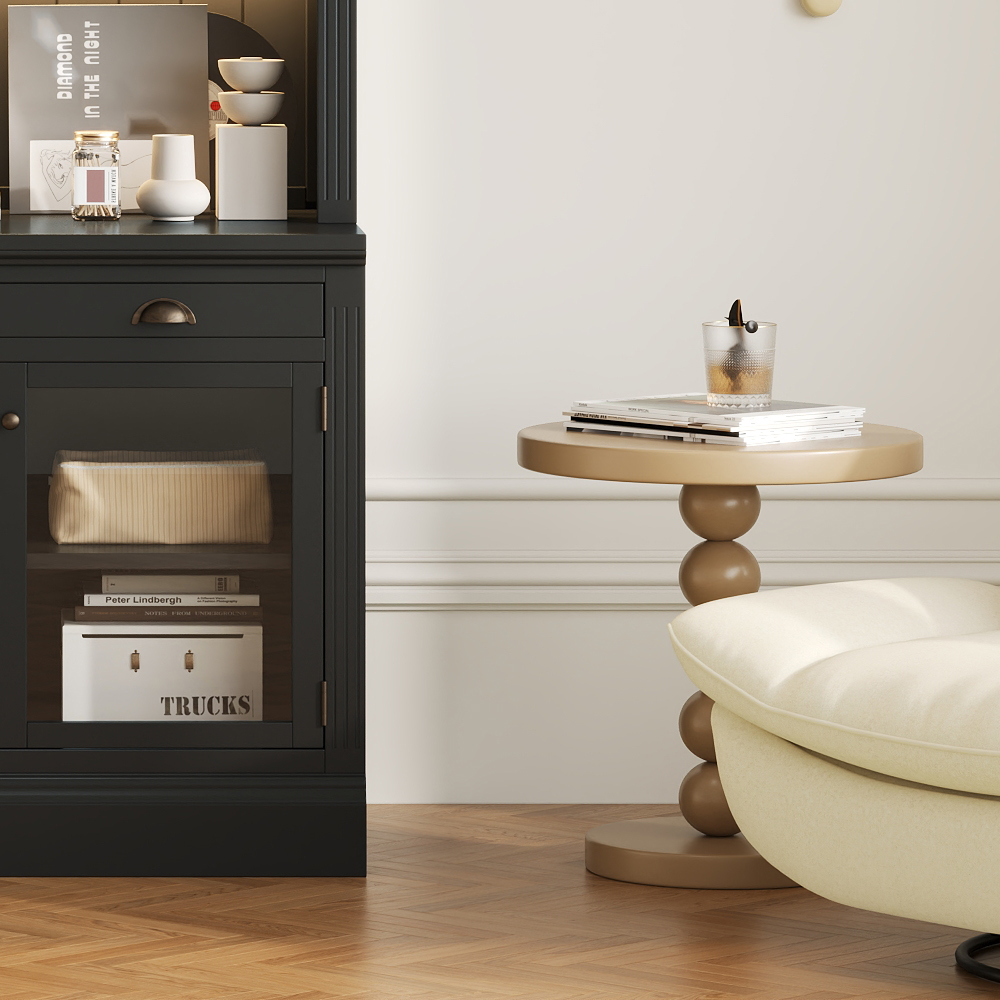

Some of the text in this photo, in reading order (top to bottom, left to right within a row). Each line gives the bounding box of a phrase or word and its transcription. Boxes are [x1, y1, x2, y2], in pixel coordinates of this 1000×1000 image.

[56, 33, 73, 100] DIAMOND
[83, 21, 100, 118] IN THE NIGHT
[105, 596, 182, 605] Peter Lindbergh
[160, 695, 251, 716] TRUCKS
